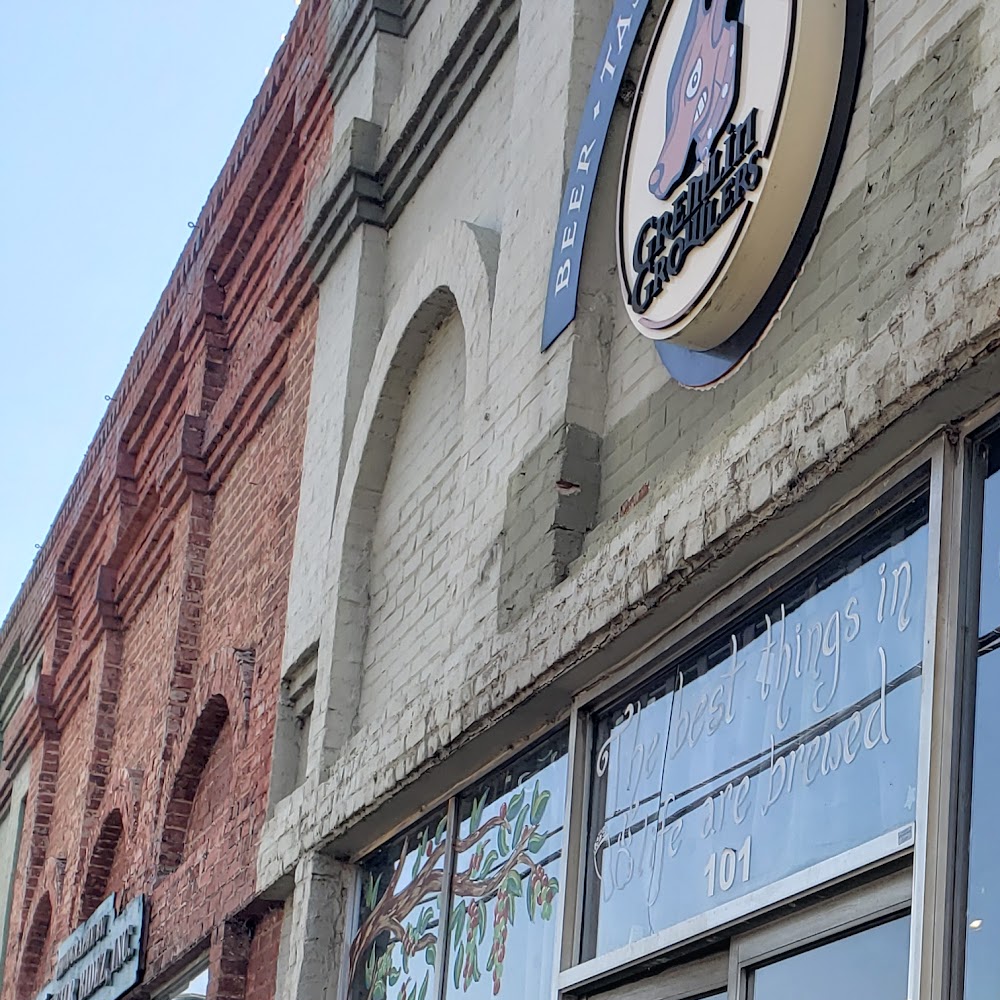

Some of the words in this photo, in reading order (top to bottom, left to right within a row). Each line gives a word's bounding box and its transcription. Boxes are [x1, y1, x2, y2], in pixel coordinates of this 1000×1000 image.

[555, 138, 597, 297] BEER
[600, 0, 640, 83] TA
[669, 634, 746, 760] best
[755, 597, 861, 730] things
[877, 561, 912, 632] in
[702, 776, 752, 840] are
[761, 646, 890, 816] brewed
[704, 835, 752, 898] 101
